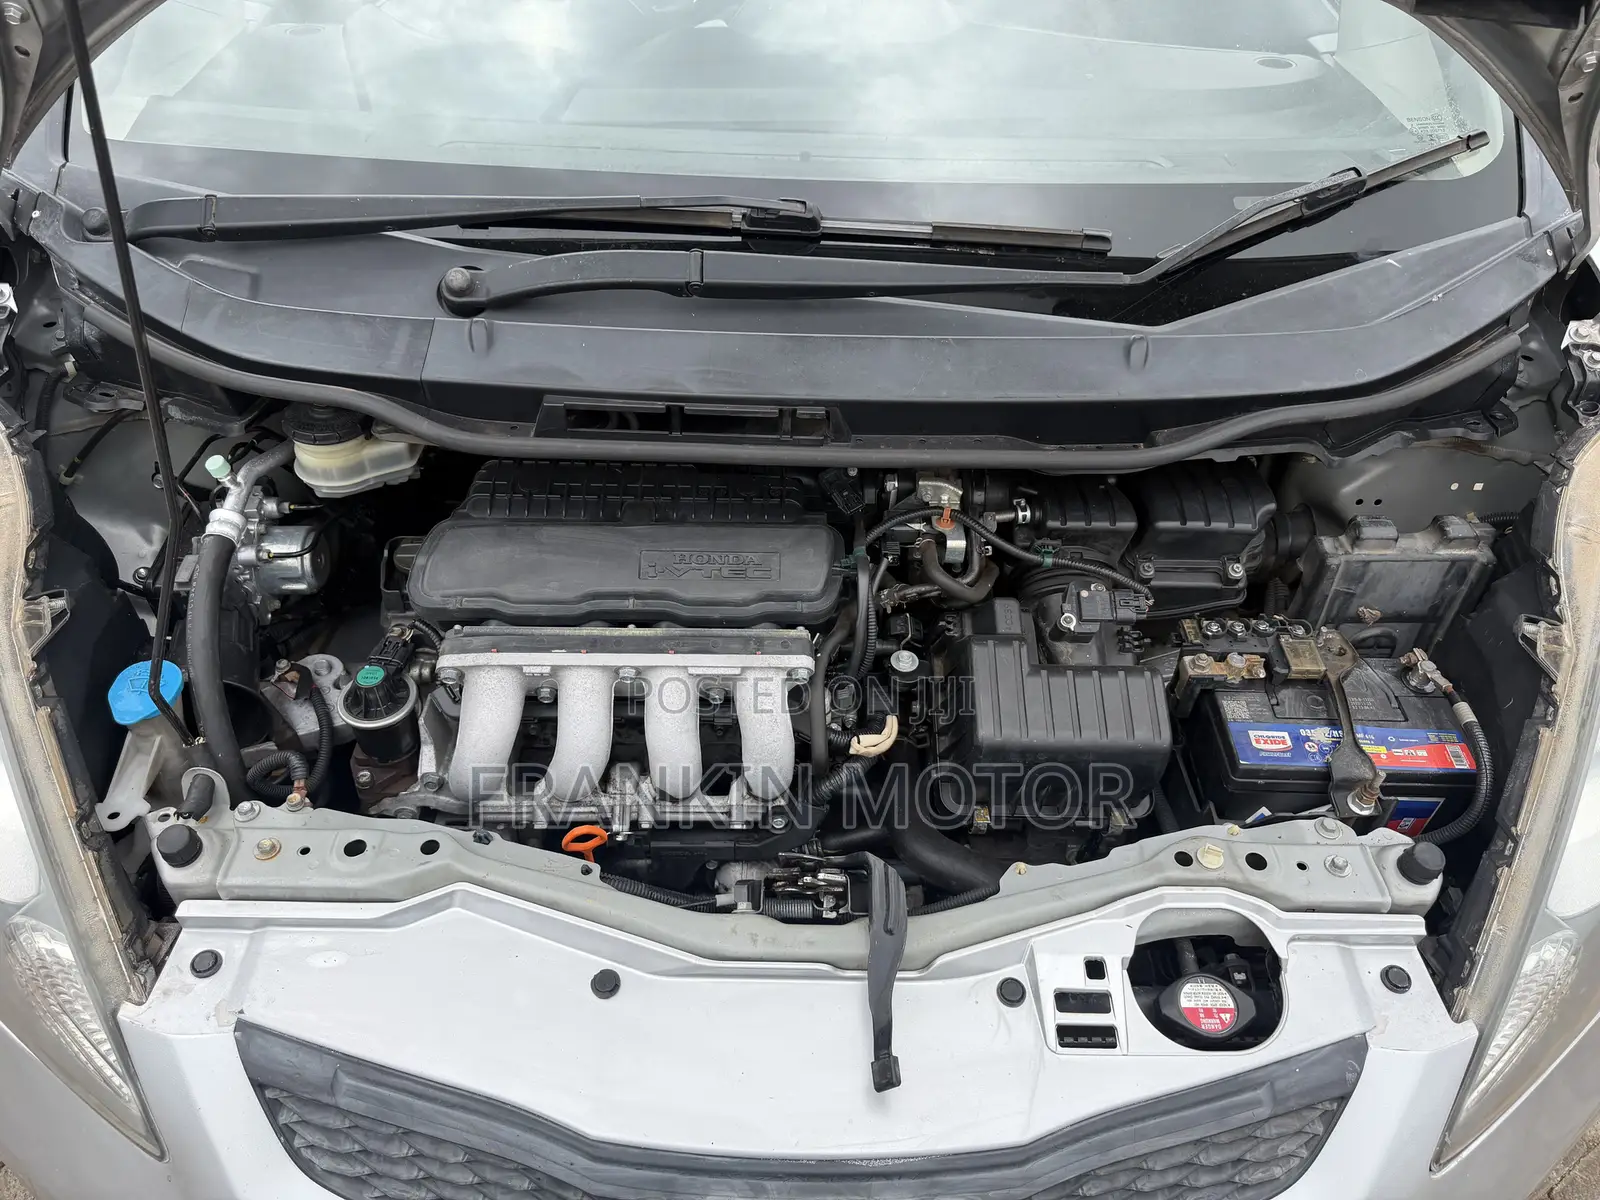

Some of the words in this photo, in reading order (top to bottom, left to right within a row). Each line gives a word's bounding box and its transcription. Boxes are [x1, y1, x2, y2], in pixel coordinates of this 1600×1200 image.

[673, 553, 762, 566] HONDA
[644, 562, 772, 580] i-VTEC
[1254, 738, 1289, 746] EXIDE
